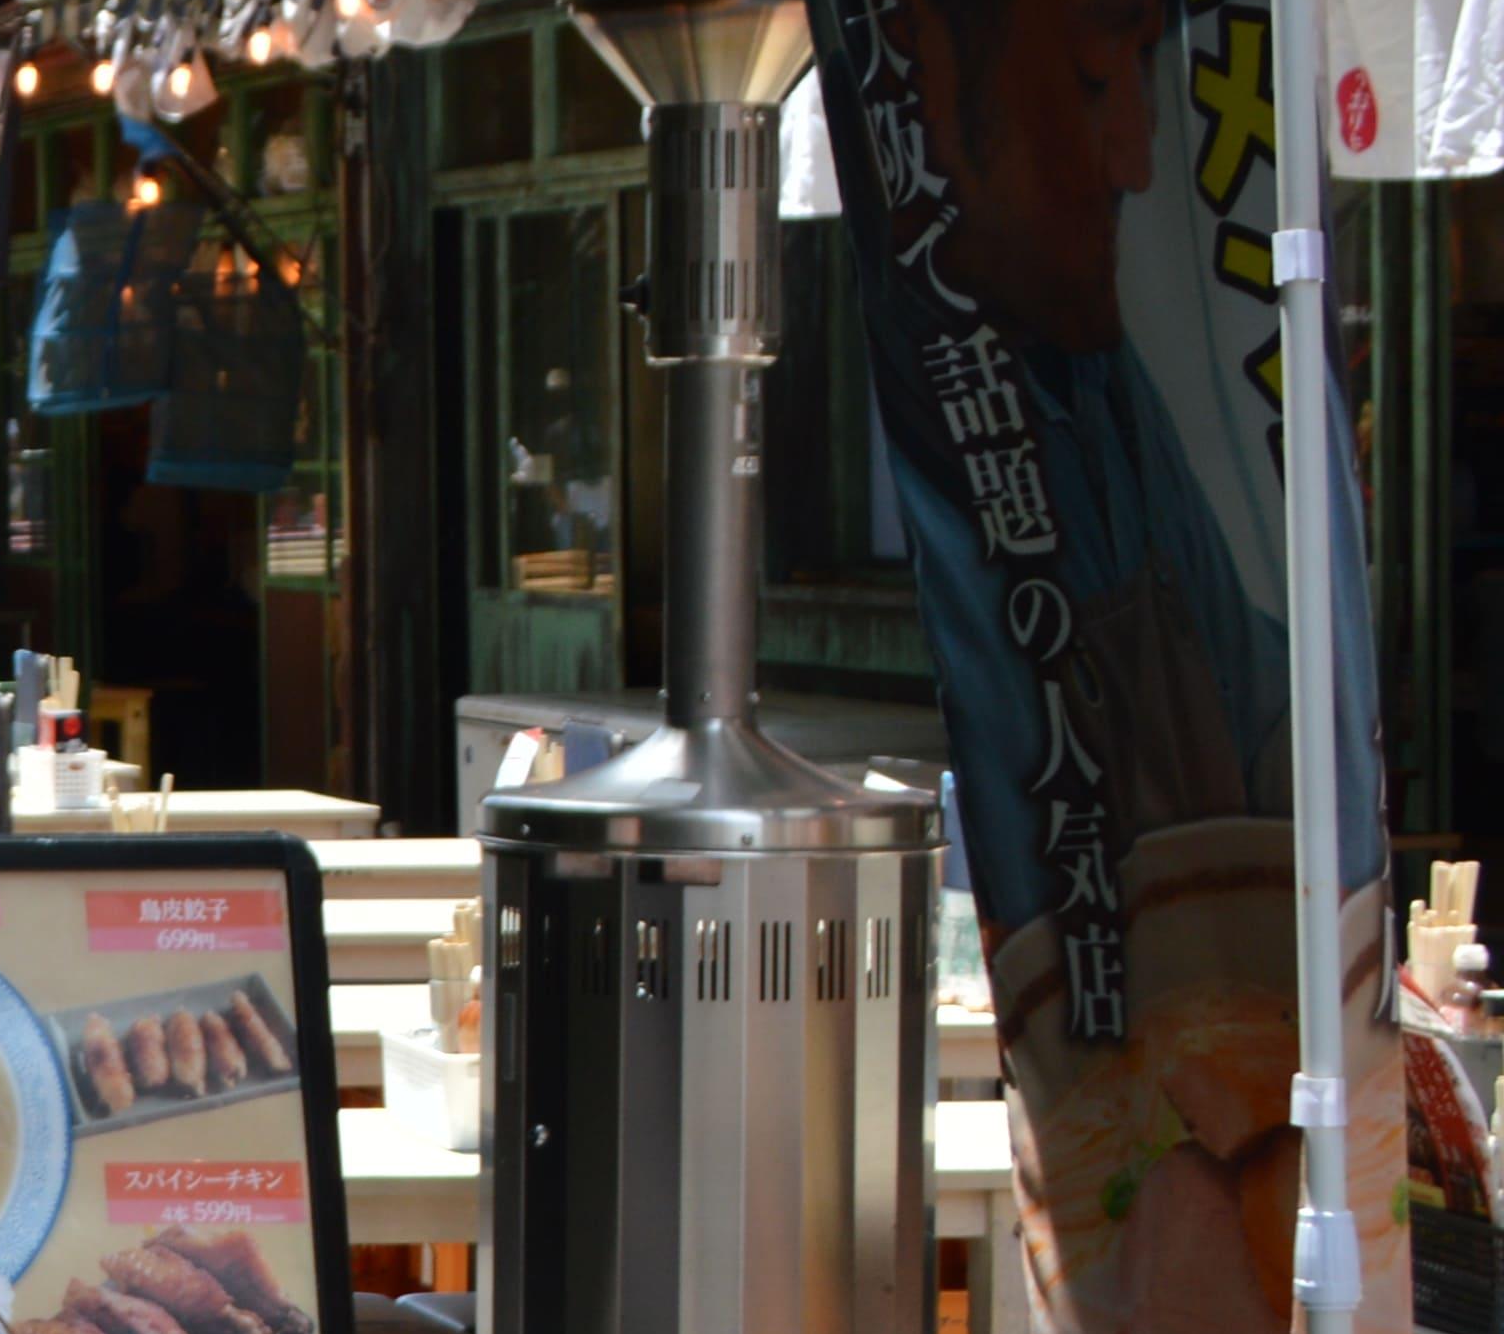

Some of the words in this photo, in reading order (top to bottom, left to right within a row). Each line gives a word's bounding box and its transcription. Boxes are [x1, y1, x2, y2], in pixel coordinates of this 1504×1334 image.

[157, 929, 215, 949] 699円
[123, 1168, 284, 1191] スパイシーチキン
[193, 1200, 252, 1222] 599円
